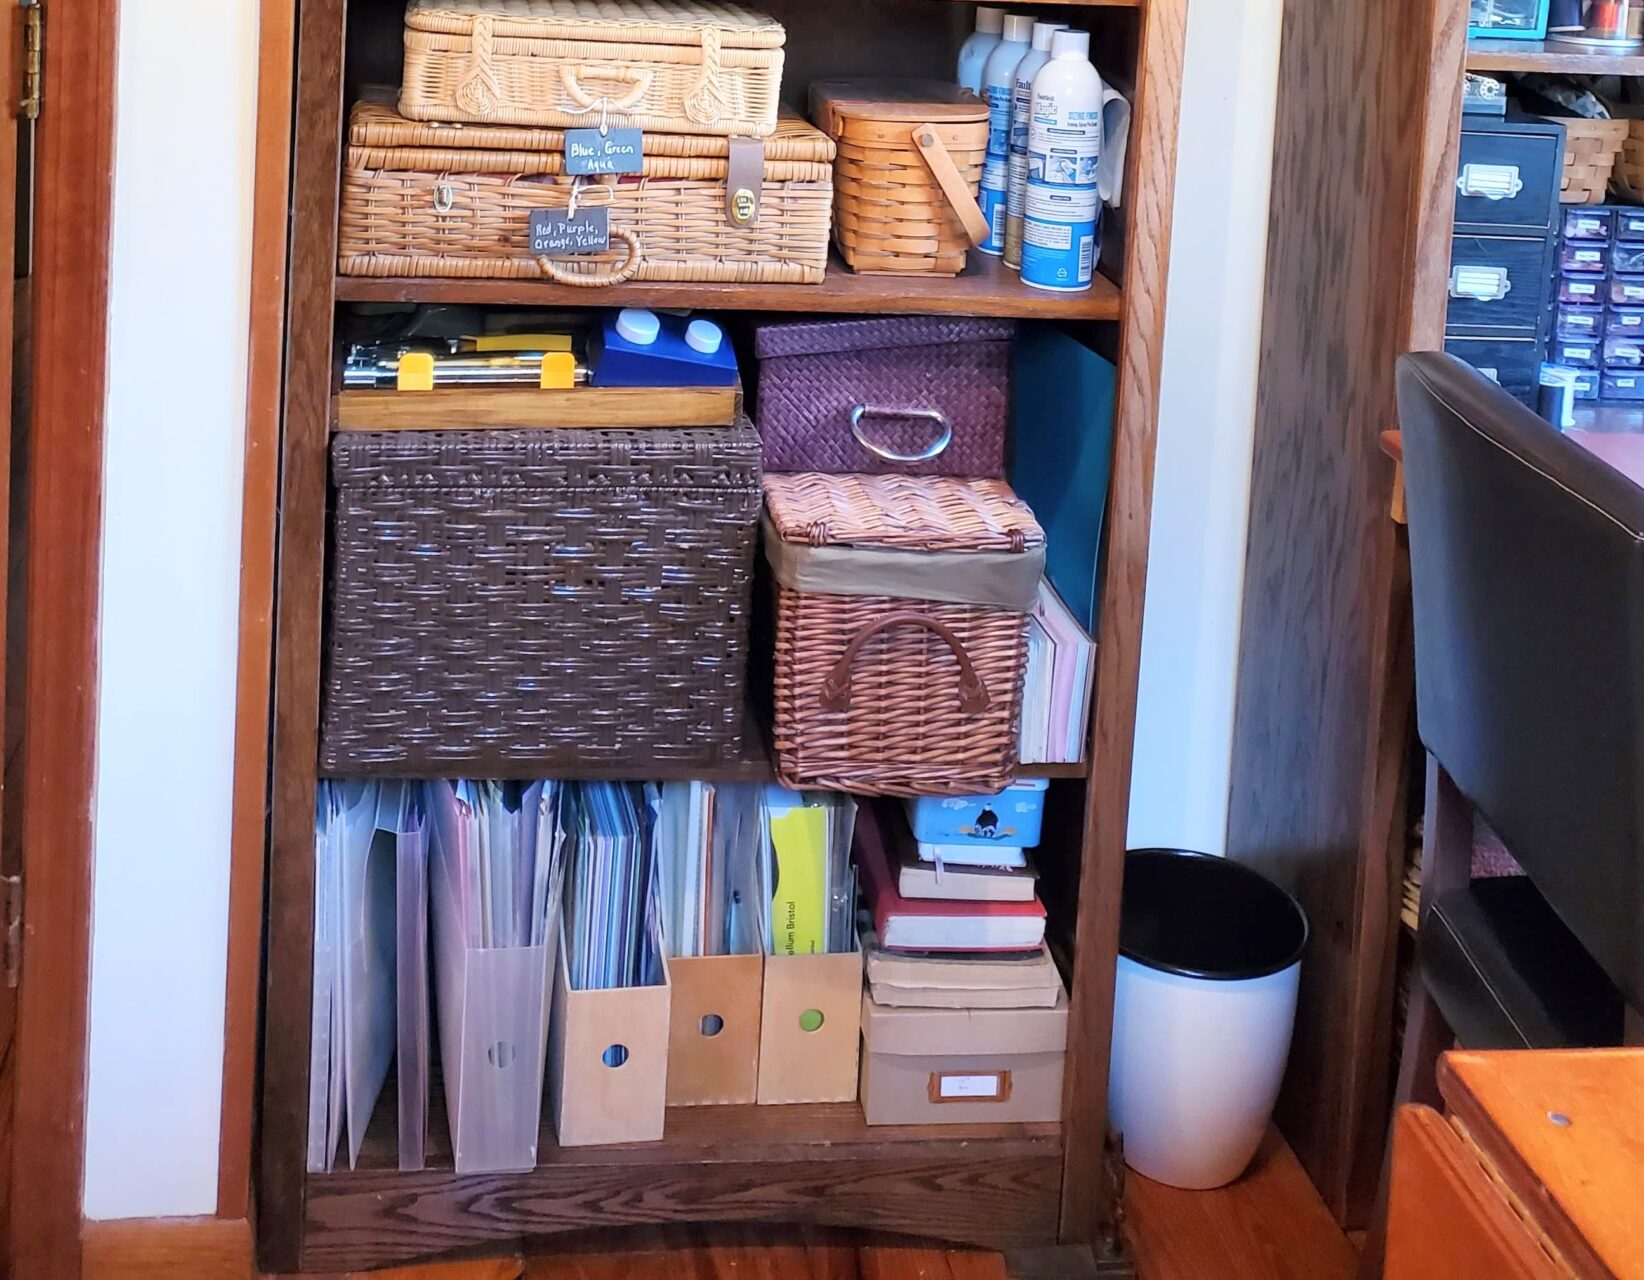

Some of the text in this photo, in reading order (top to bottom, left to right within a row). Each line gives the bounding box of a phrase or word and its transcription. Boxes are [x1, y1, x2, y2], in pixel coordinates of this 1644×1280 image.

[571, 140, 634, 157] Blue, Green
[587, 159, 614, 173] Aqua
[535, 220, 598, 237] Red, Purple,
[534, 235, 606, 250] Orange, Yellow
[785, 901, 796, 956] ellum Bristol
